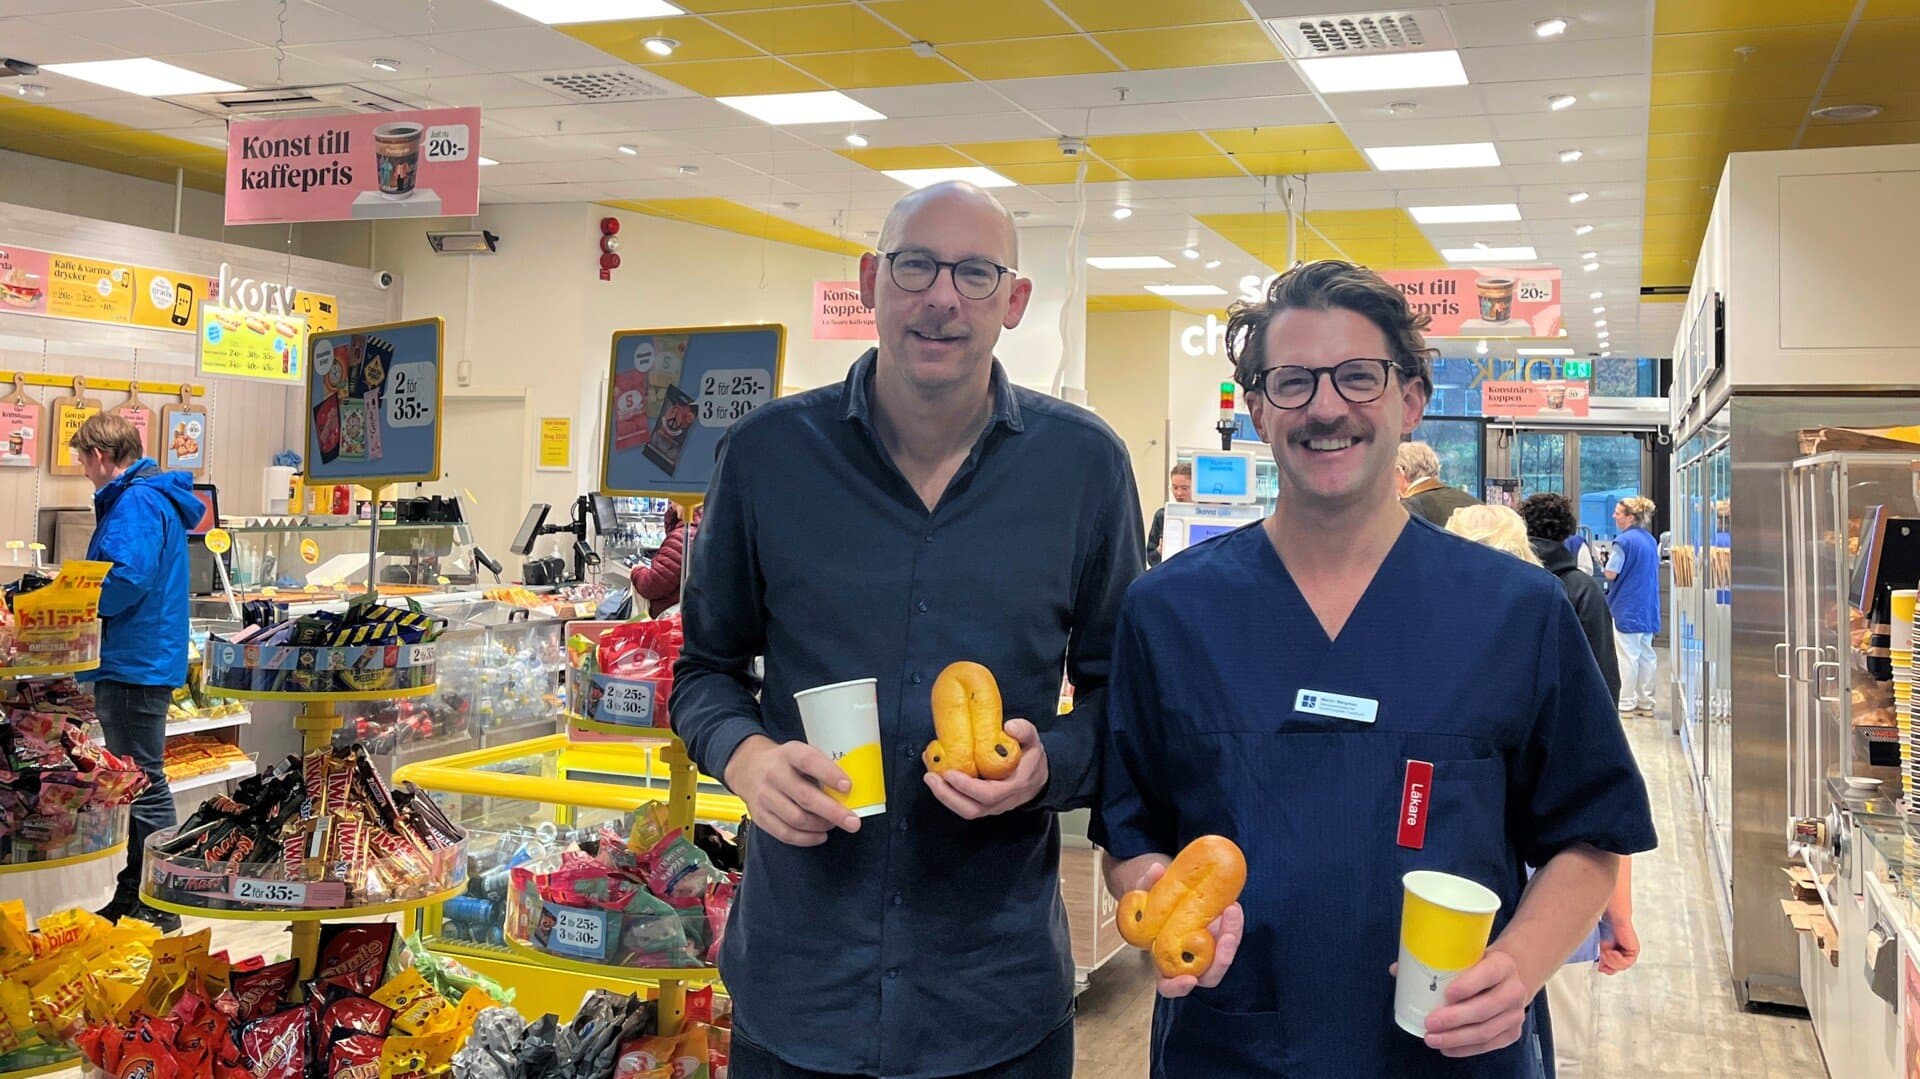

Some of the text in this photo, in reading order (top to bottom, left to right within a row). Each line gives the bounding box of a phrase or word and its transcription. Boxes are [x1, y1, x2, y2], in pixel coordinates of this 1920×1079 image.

[242, 129, 350, 160] Konst till
[428, 138, 465, 157] 20:-
[241, 161, 353, 192] kaffepris
[54, 259, 77, 270] Kaffe
[54, 270, 87, 281] drycker
[219, 262, 297, 316] korv
[1430, 279, 1457, 295] till
[1520, 288, 1550, 299] 20:-
[395, 372, 406, 395] 2
[407, 379, 418, 393] för
[704, 376, 765, 396] 2 för 25:-
[394, 398, 429, 421] 35:-
[703, 401, 713, 420] 3
[716, 406, 729, 419] för
[414, 648, 420, 662] 2
[607, 686, 615, 697] 2
[623, 688, 646, 699] 25:-
[606, 699, 614, 710] 3
[622, 702, 646, 713] 30:-
[306, 754, 325, 798] TWIX
[1407, 783, 1424, 826] Läkare
[337, 821, 359, 862] TWIX
[283, 836, 305, 881] TWIX
[184, 878, 221, 891] Mars
[240, 883, 300, 901] 2 för 35:-
[559, 914, 566, 925] 2
[576, 917, 599, 930] 25:-
[49, 924, 81, 949] bilar
[559, 927, 566, 939] 3
[575, 932, 599, 944] 30:-
